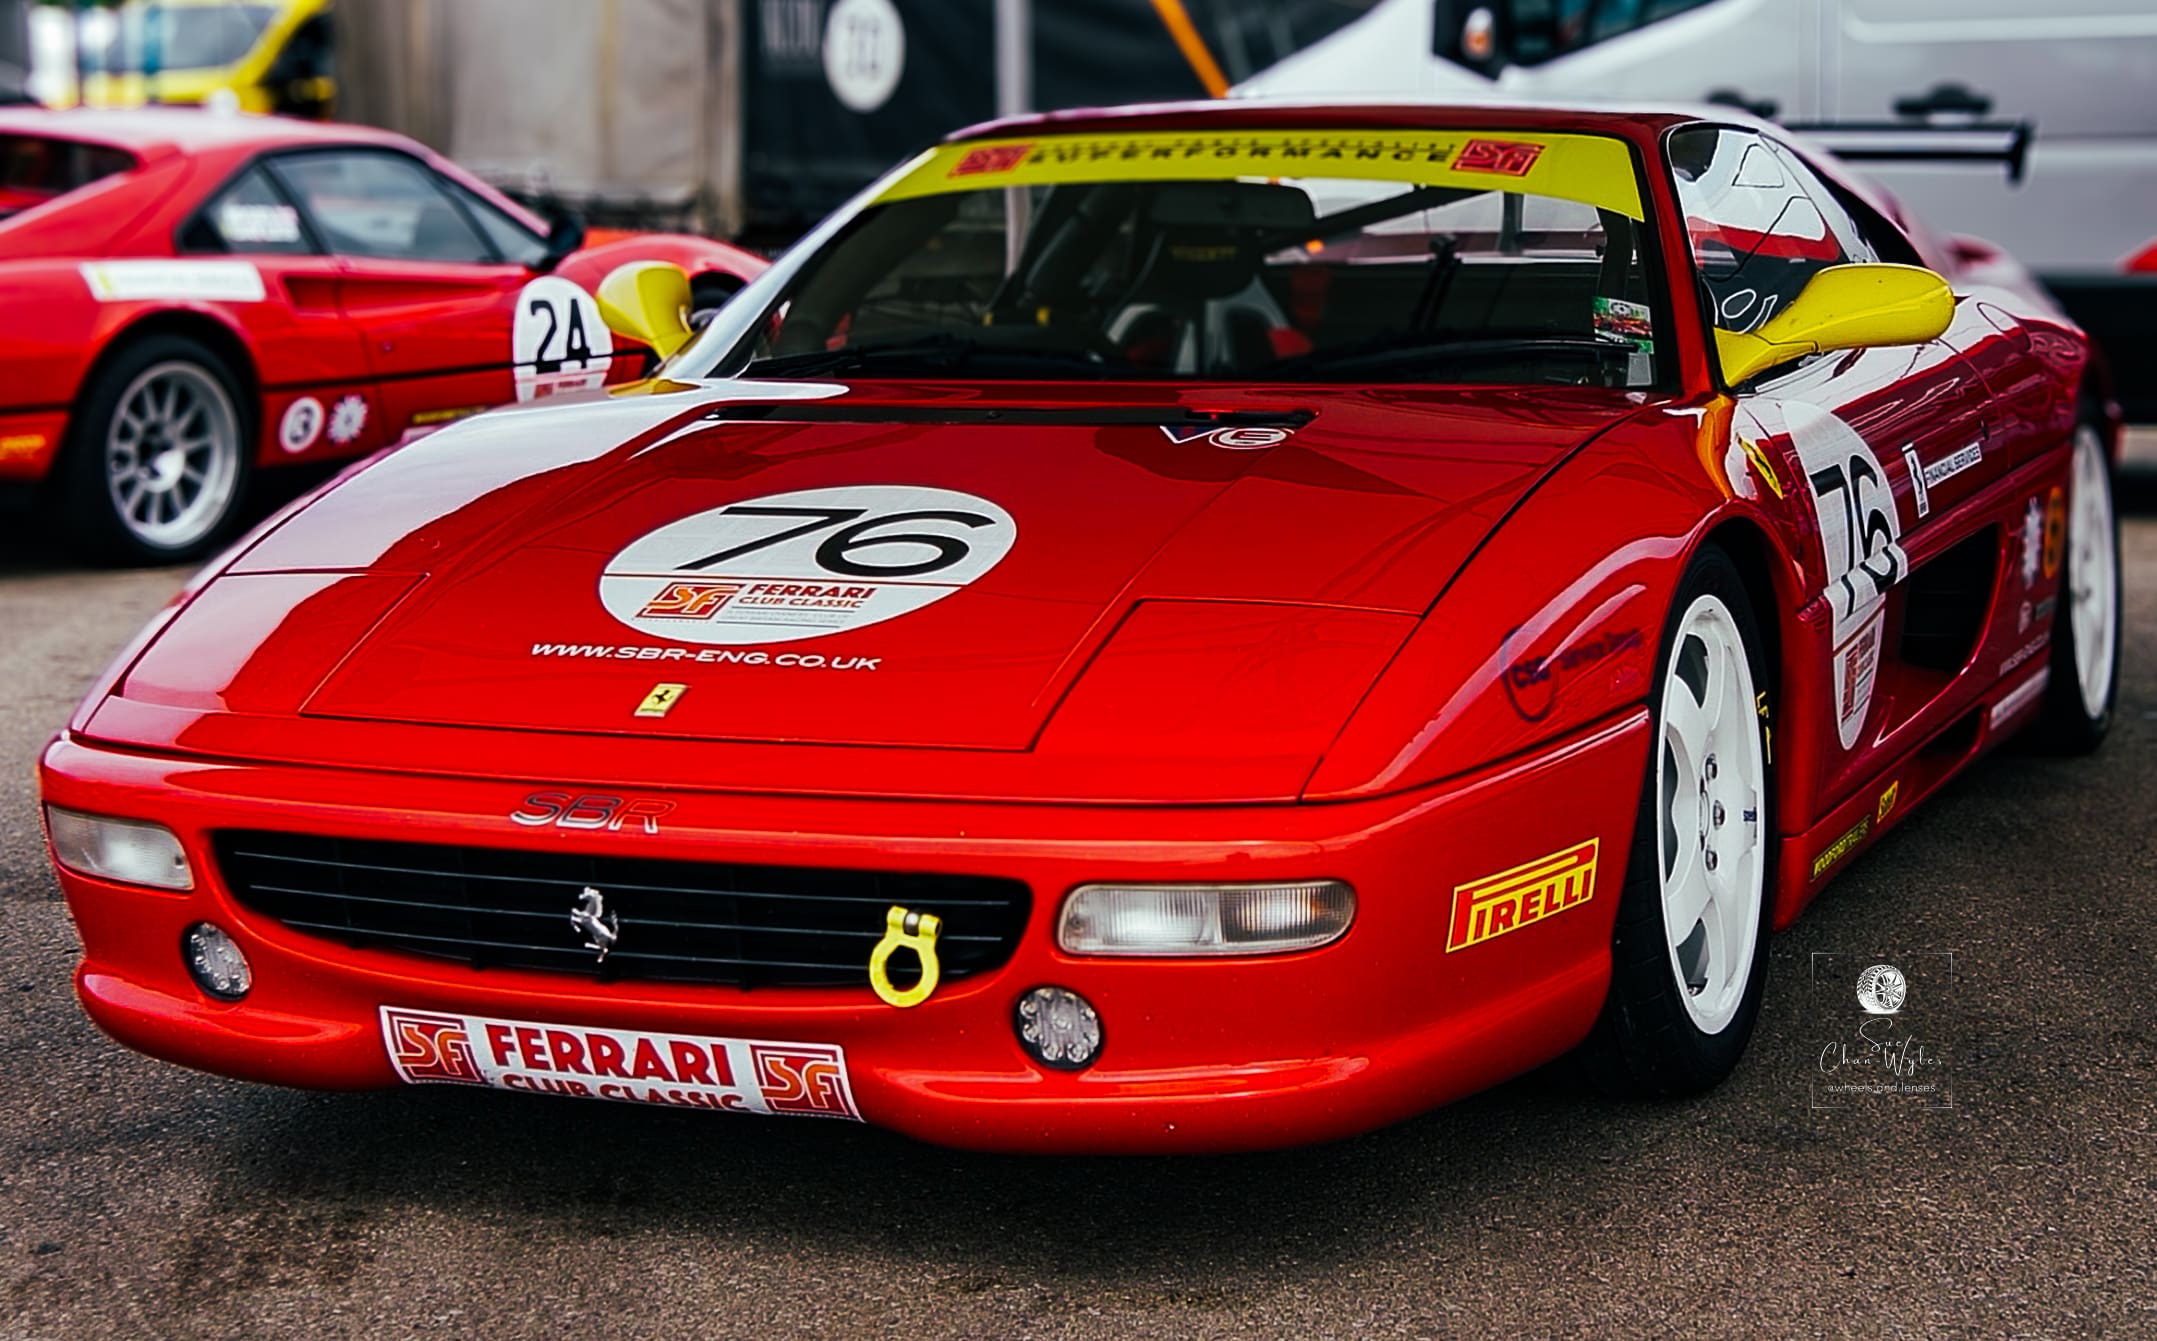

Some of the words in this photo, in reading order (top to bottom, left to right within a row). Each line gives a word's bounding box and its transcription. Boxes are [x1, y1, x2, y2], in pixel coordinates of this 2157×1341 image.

[530, 299, 592, 375] 24
[673, 505, 997, 578] 76
[1809, 454, 1899, 618] 76
[738, 596, 787, 606] CLUB
[788, 598, 864, 609] CLASSIC
[747, 583, 877, 599] FERRARI
[510, 792, 677, 835] SBR
[1450, 843, 1596, 949] PIRELLI
[485, 1023, 737, 1087] FERRARI
[502, 1073, 596, 1098] CLUB
[599, 1083, 749, 1110] CLASSIC
